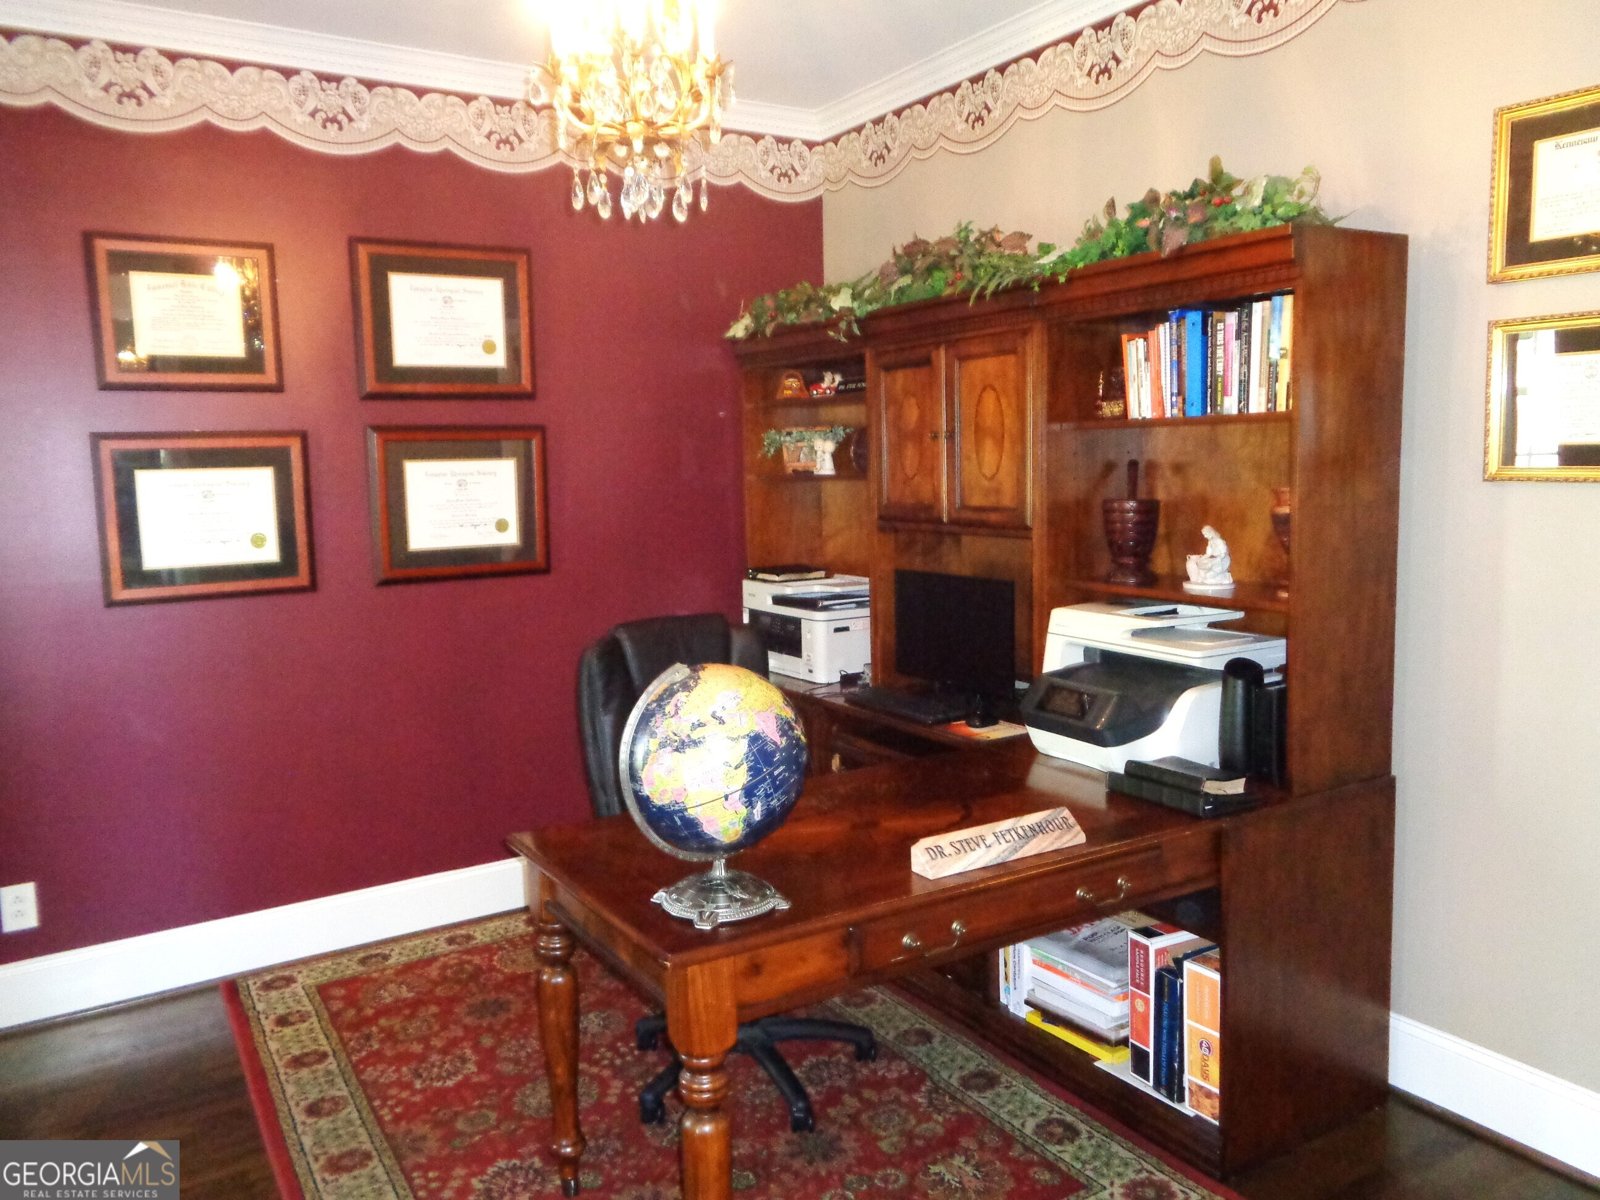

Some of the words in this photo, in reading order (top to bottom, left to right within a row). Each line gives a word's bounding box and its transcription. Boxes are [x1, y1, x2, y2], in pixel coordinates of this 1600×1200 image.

[925, 846, 952, 861] DR.
[950, 834, 992, 855] STEVE
[992, 816, 1075, 846] FETKENHOUR
